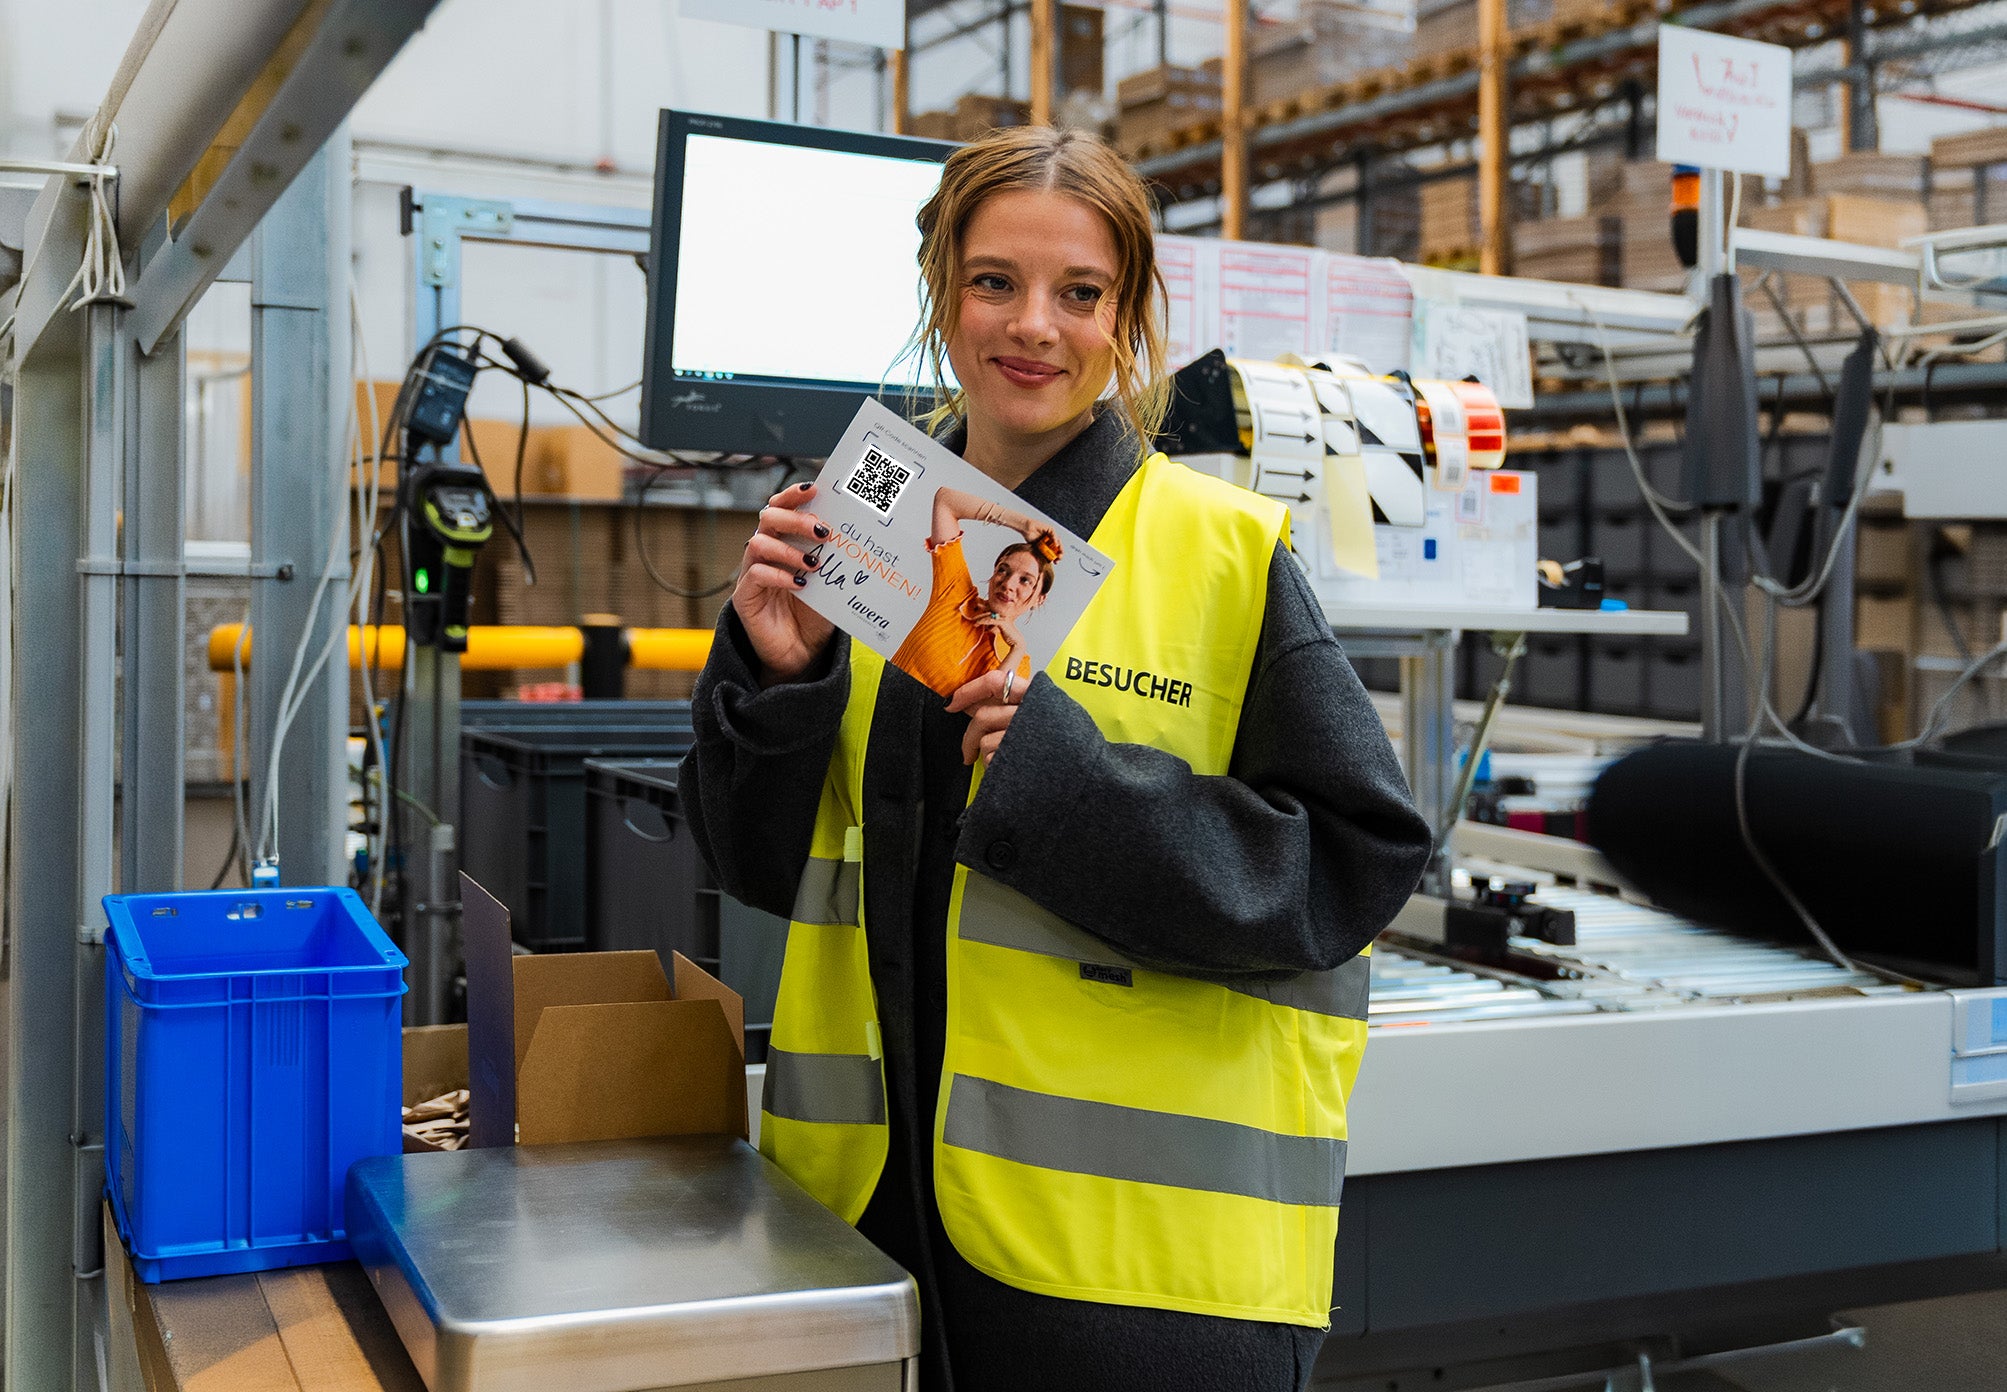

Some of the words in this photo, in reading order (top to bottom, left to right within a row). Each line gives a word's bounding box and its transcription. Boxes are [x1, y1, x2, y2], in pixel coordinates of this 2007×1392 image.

[840, 522, 862, 542] du
[863, 535, 900, 567] hast
[847, 595, 891, 630] lavera
[1065, 656, 1193, 708] BESUCHER
